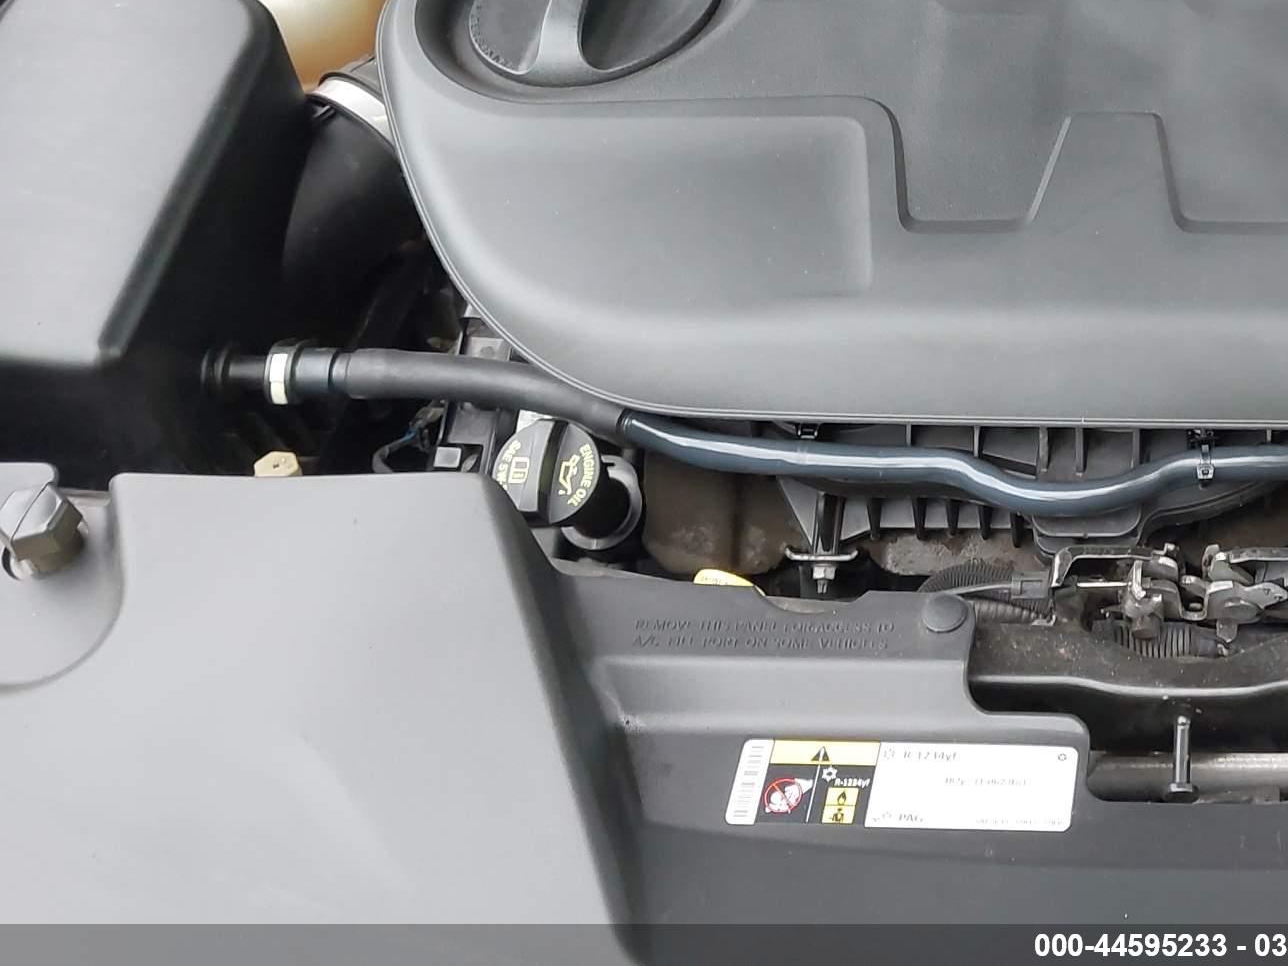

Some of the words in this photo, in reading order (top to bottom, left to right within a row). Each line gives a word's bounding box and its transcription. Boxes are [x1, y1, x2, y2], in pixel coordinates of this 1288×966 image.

[502, 439, 521, 463] SAE
[578, 443, 595, 489] ENGINE
[566, 487, 587, 507] OIL
